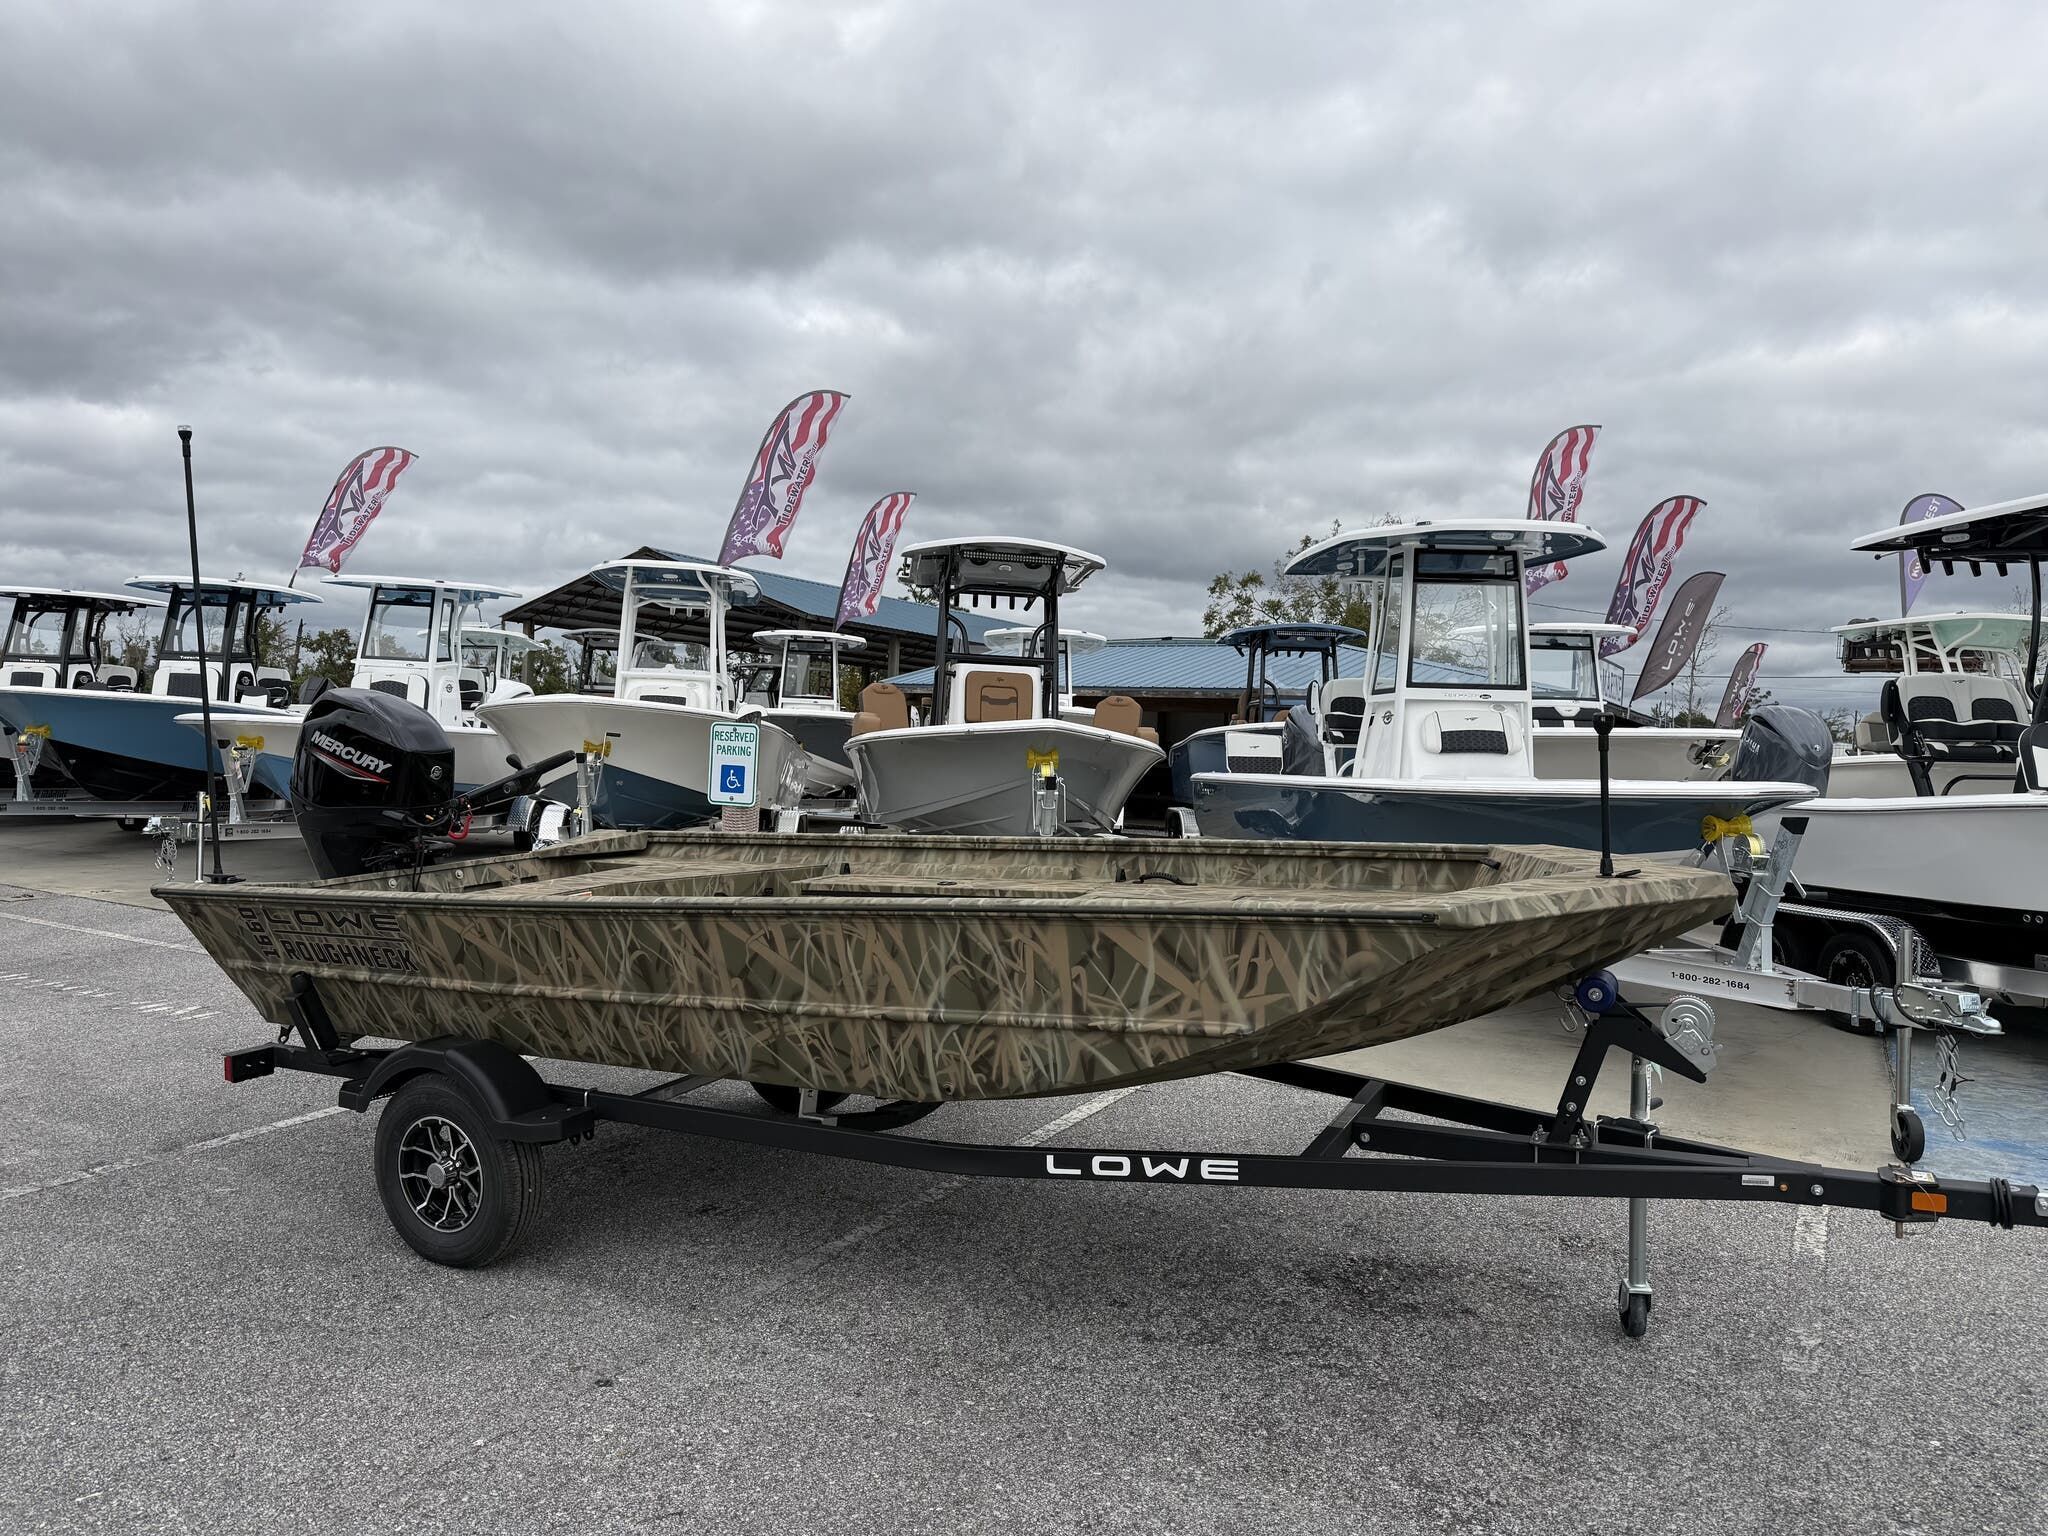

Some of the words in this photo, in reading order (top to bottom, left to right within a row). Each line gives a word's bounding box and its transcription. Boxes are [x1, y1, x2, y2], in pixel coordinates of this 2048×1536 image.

[776, 458, 812, 527] TIDEWATER
[1565, 485, 1578, 522] WATER
[340, 495, 380, 545] TIDEWATER
[1525, 567, 1566, 579] GARIN
[1637, 561, 1669, 626] TIDEWATER
[1662, 600, 1696, 671] LOWE
[311, 730, 392, 774] MERCURY
[714, 730, 755, 743] RESERVED
[716, 744, 752, 757] PARKING
[262, 908, 401, 932] LOWE
[280, 939, 420, 972] ROUGHNECK
[1671, 971, 1750, 991] 1-800-282-1684
[1046, 1154, 1239, 1181] LOWE
